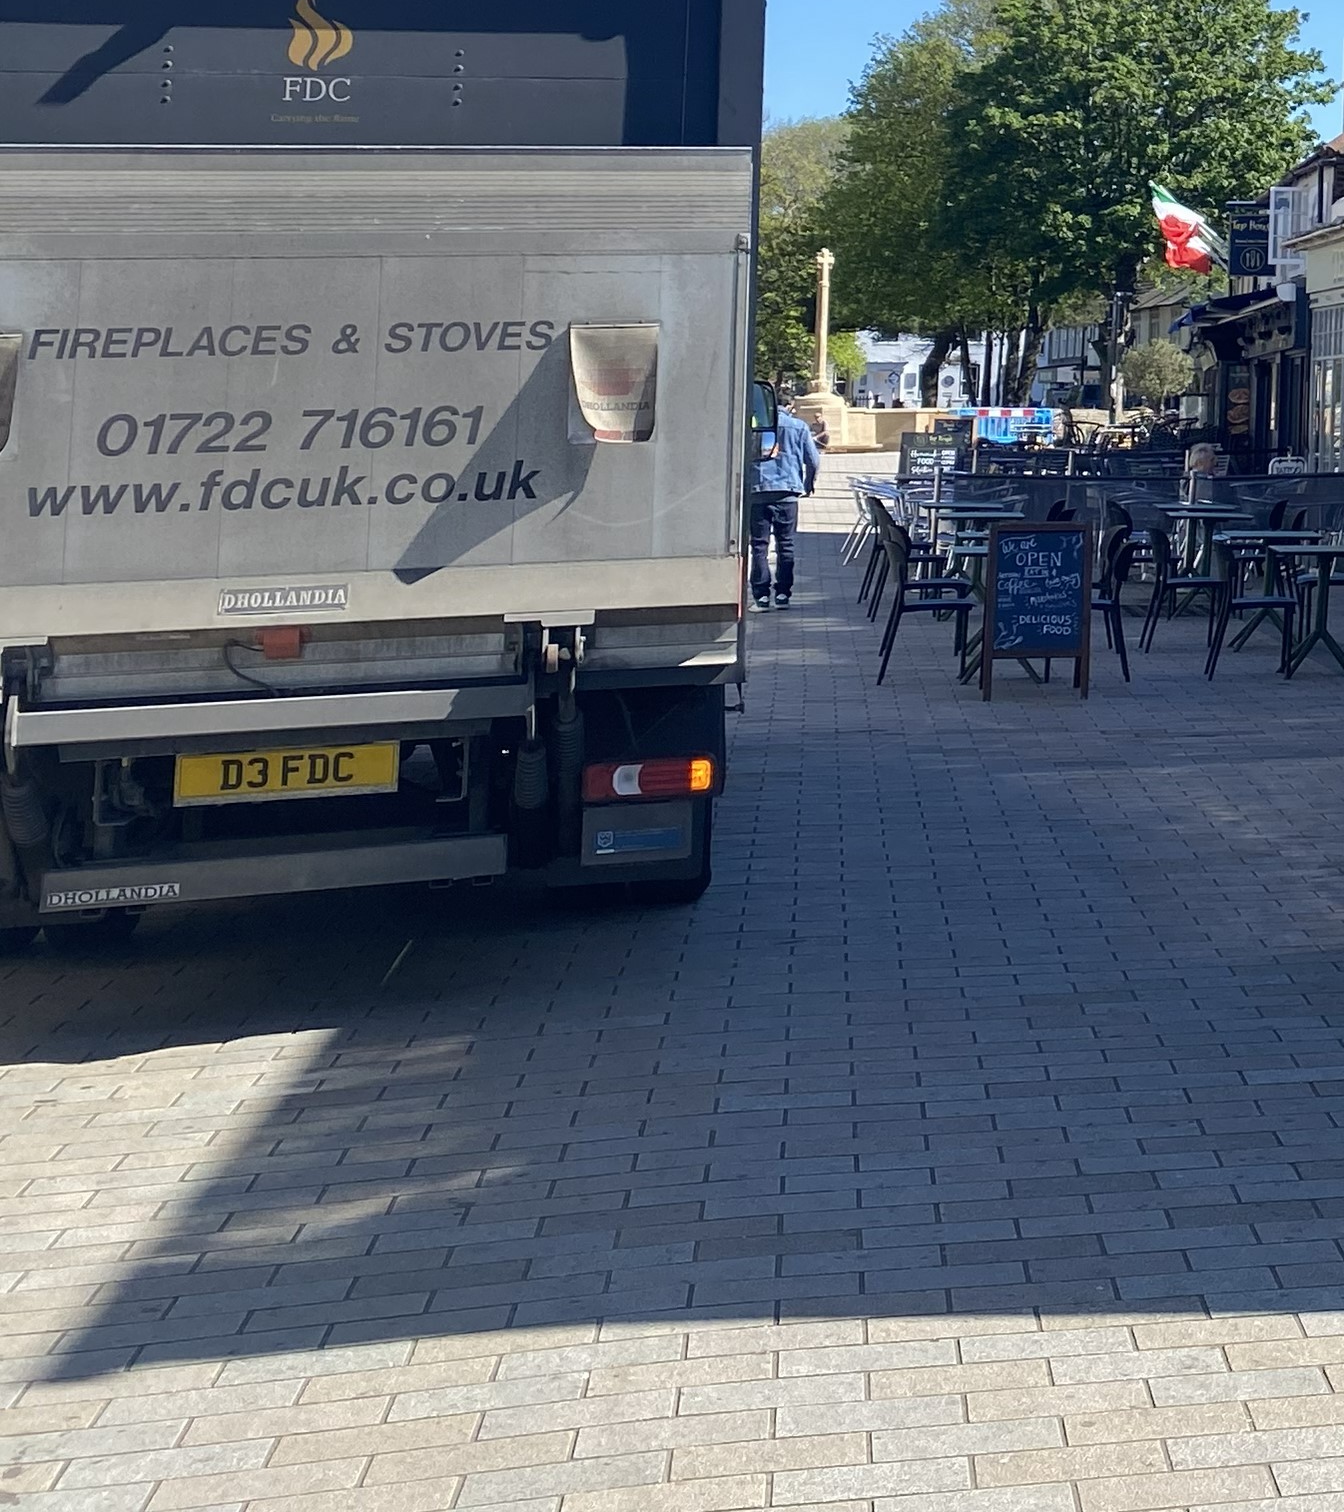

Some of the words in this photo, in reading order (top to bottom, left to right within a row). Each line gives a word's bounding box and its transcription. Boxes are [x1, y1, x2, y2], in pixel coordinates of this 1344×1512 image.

[282, 77, 351, 102] FDC
[27, 323, 313, 361] FIREPLACES
[330, 324, 362, 355] &
[383, 320, 556, 353] STOVES
[582, 401, 650, 411] DHOLLANDIA
[95, 408, 273, 458] 01722
[299, 403, 485, 450] 716161
[27, 460, 542, 518] www.fdcuk.co.uk
[1016, 551, 1063, 567] OPEN
[221, 588, 347, 610] DHOLLANDIA
[1019, 614, 1072, 625] DELICIOUS
[1043, 624, 1072, 635] FOOD
[220, 757, 269, 791] D3
[281, 752, 354, 788] FDC
[49, 884, 178, 908] DHOLLANDIA
